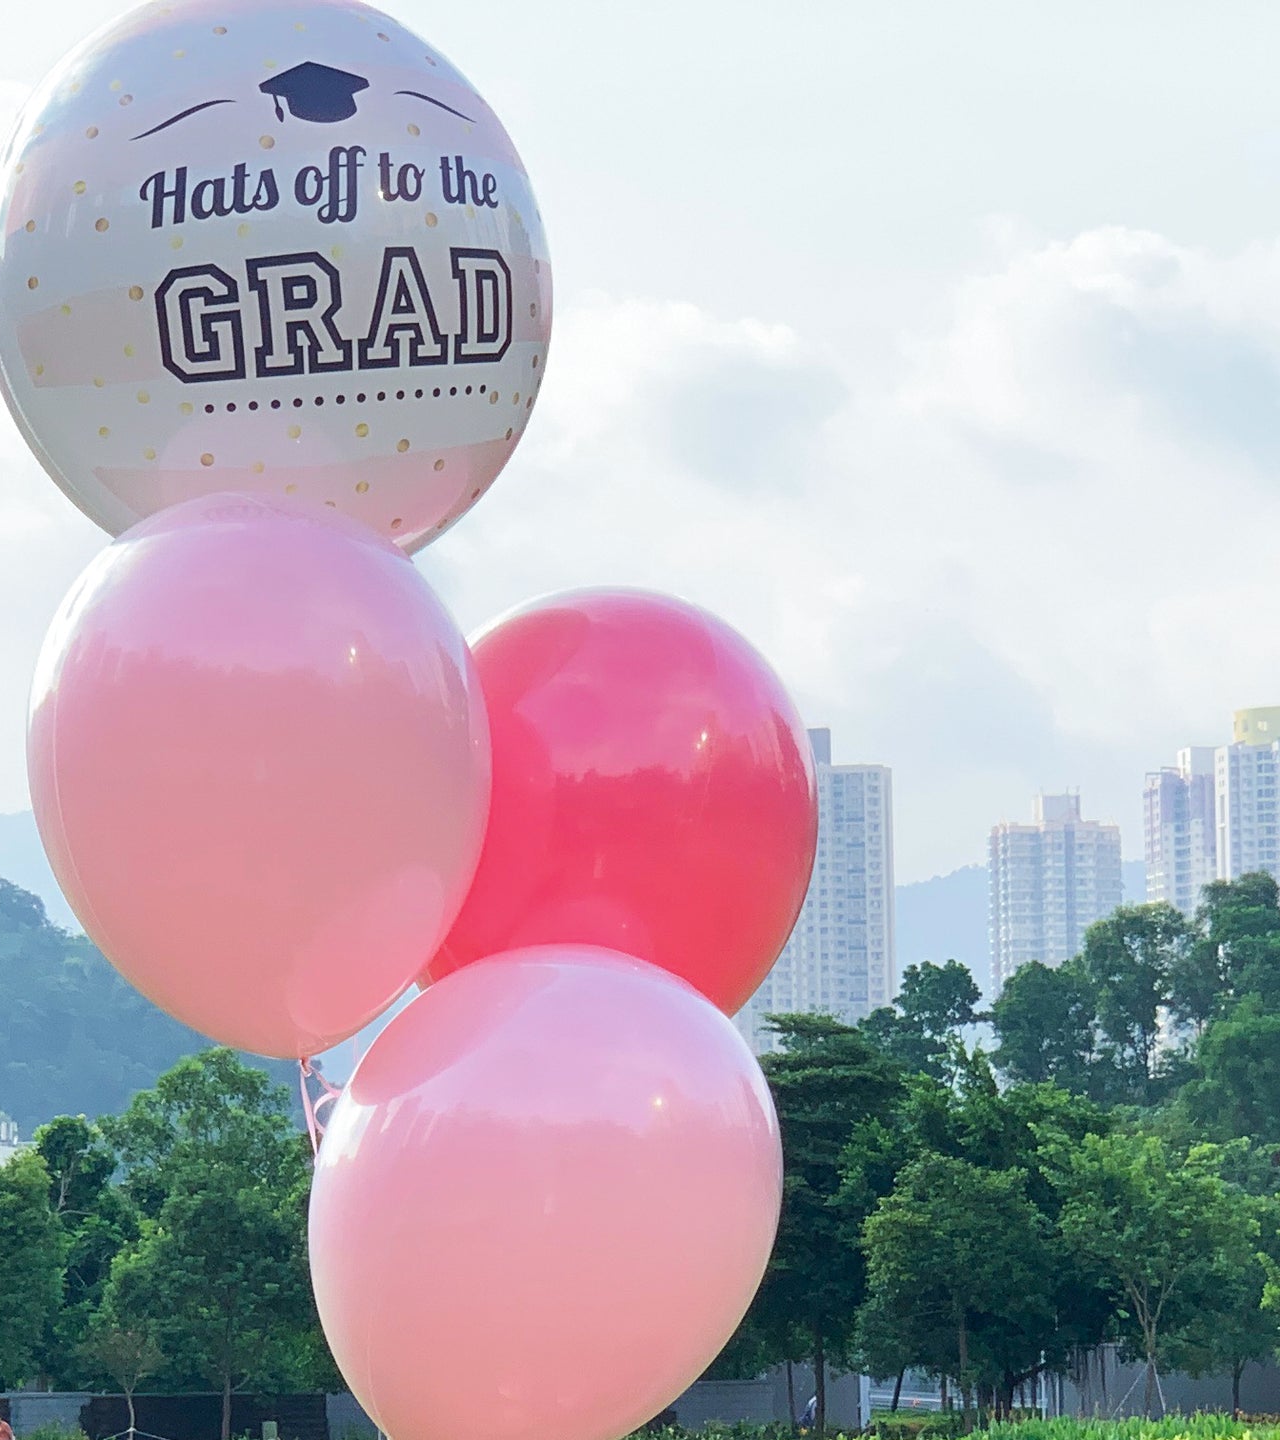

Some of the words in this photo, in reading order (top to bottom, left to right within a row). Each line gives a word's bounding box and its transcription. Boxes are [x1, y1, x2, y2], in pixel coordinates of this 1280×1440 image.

[139, 162, 280, 229] Hats
[294, 145, 367, 224] off
[377, 152, 426, 202] to
[439, 155, 499, 209] the
[153, 246, 513, 384] GRAD
